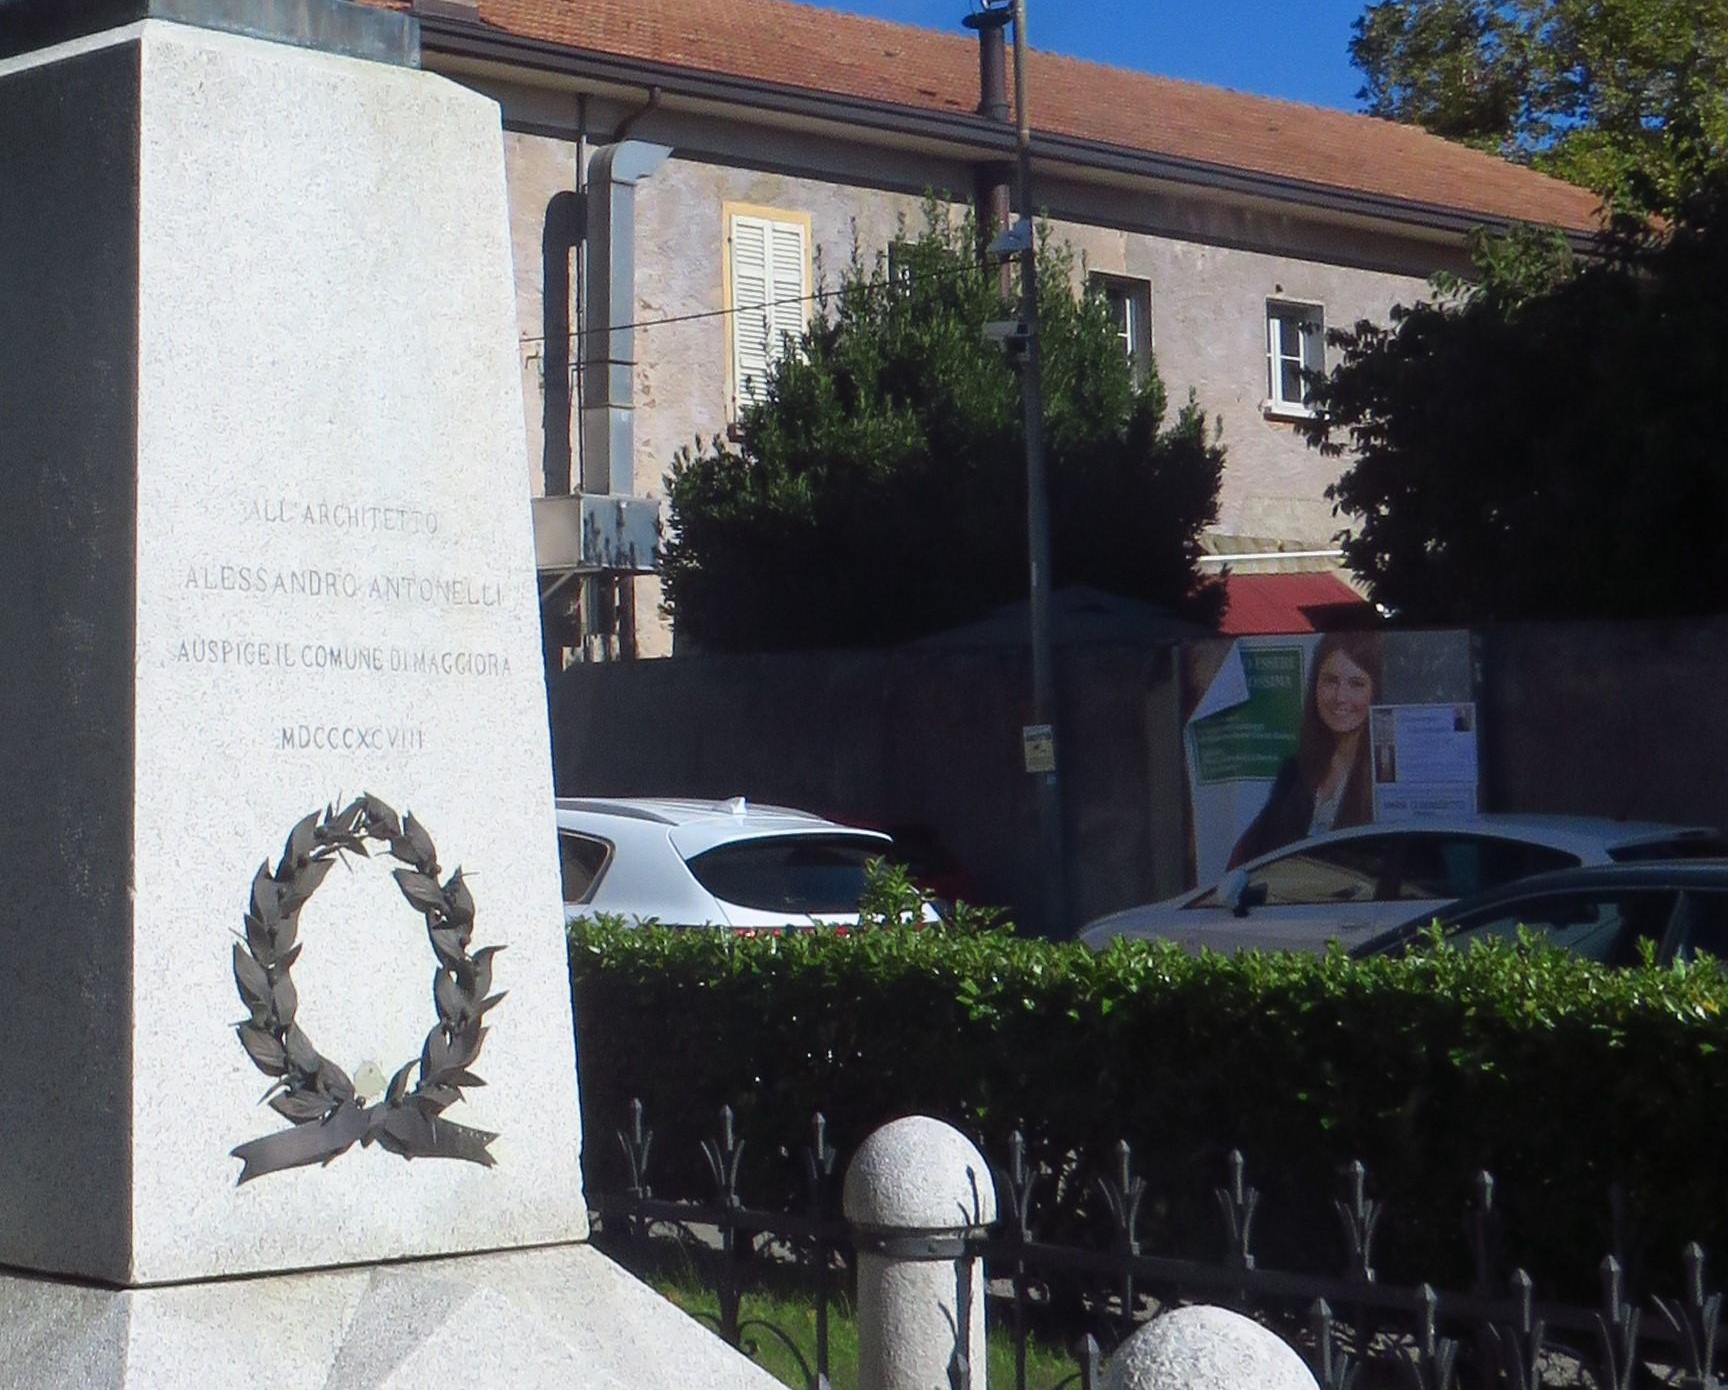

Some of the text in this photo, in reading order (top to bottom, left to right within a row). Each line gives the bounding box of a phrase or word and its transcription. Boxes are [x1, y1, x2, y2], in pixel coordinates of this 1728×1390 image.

[185, 565, 503, 607] ALESSANDRO ANTONELLI
[275, 642, 296, 668] IL
[301, 644, 384, 672] COMUNE
[391, 648, 408, 673] DI
[413, 650, 512, 678] MAGGIORA
[281, 724, 424, 750] MDCCCXCVIII
